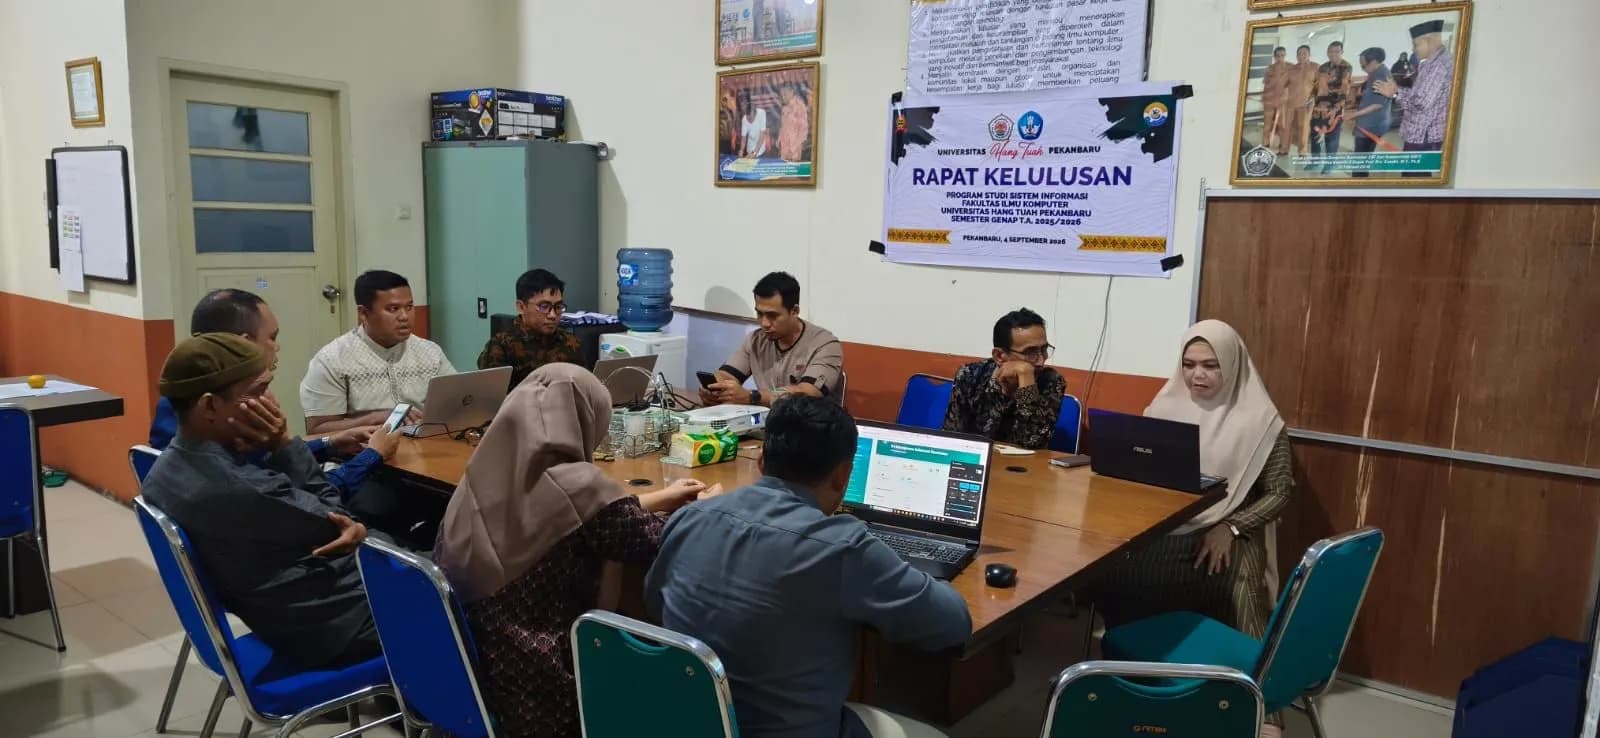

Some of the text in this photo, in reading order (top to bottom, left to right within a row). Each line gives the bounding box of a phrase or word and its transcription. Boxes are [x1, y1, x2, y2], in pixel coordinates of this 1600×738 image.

[1079, 11, 1126, 21] menerapkan
[1059, 22, 1092, 31] diperoleh
[1083, 28, 1119, 37] komputer
[1088, 43, 1123, 52] teknologi
[1074, 68, 1120, 76] menciptakan
[1038, 79, 1081, 87] memberikan
[1089, 76, 1120, 85] peluang
[937, 140, 1101, 162] UNIVERSITAS Hang Tuah PEKANBARU
[912, 165, 1133, 186] RAPAT KELULUSAN
[1010, 192, 1039, 200] SISTEM
[1041, 192, 1088, 200] INFORMASI
[1001, 200, 1021, 208] ILMU
[991, 208, 1014, 216] HANG
[1039, 209, 1092, 217] PEKANBARU
[1019, 217, 1034, 225] T.A.
[1035, 218, 1082, 226] 2025/2026
[963, 235, 1003, 243] PEKANBARU,
